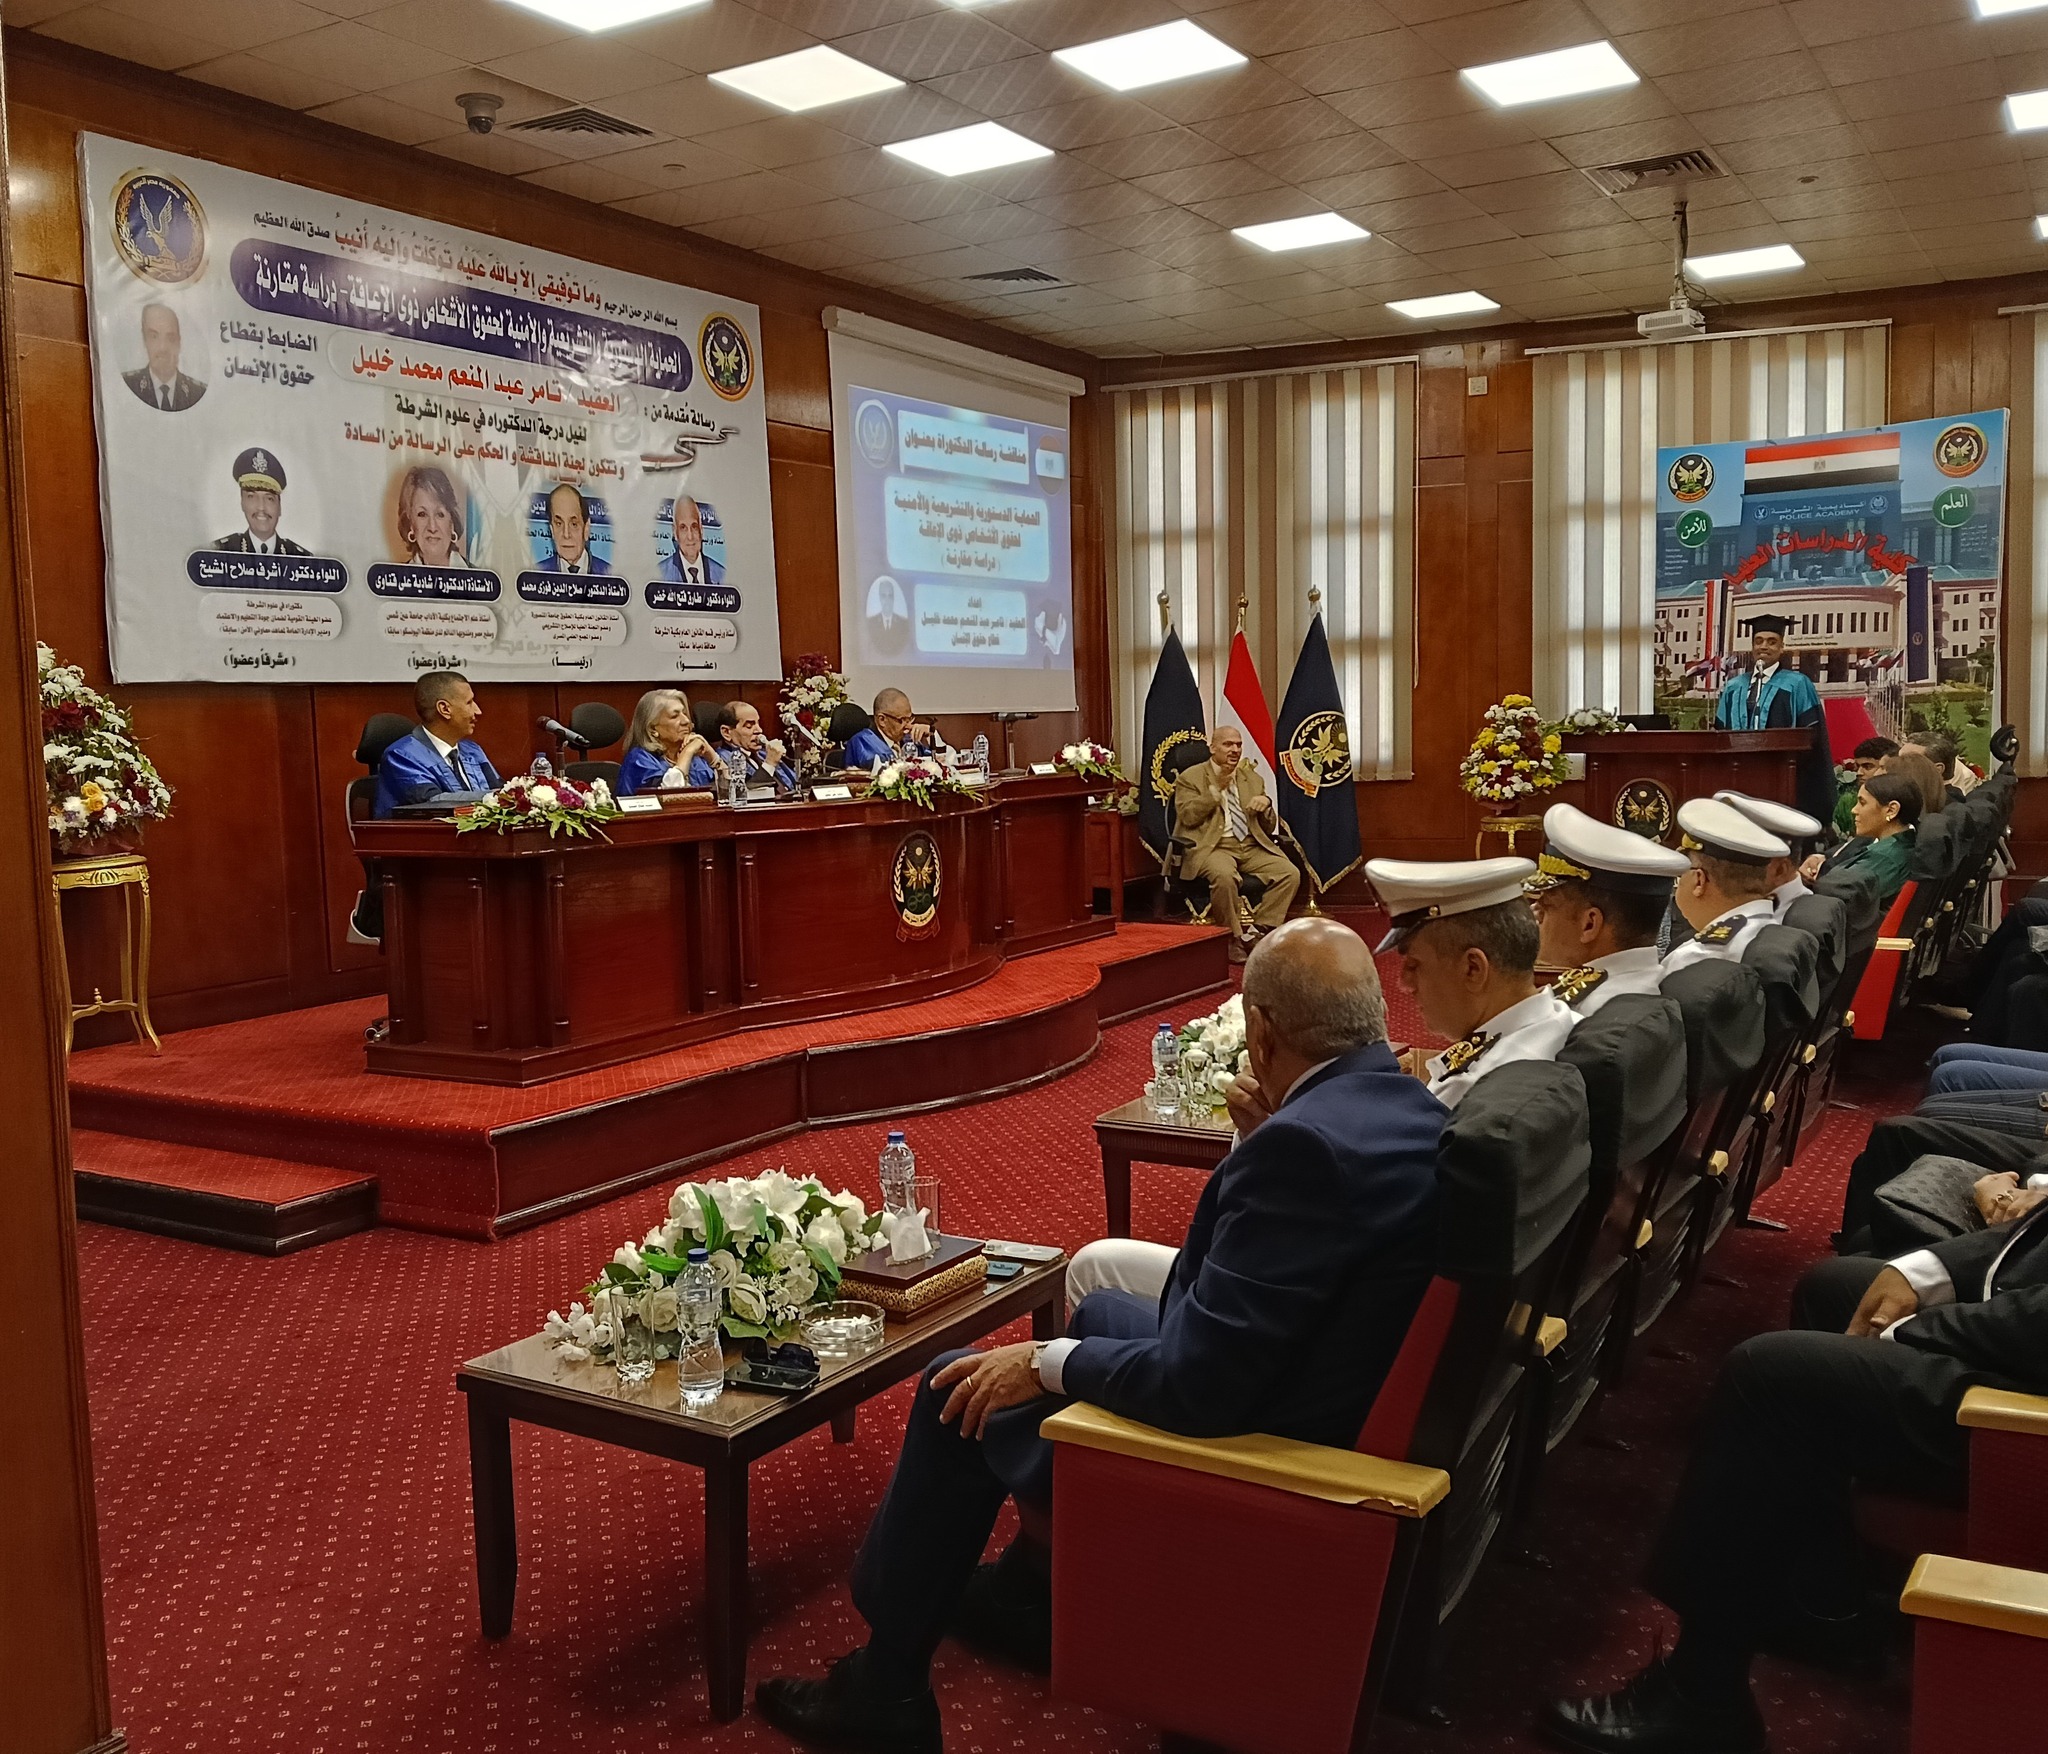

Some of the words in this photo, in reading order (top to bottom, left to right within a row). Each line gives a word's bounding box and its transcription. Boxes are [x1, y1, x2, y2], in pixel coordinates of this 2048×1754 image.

[252, 211, 288, 230] العظيم
[290, 217, 306, 233] الله
[307, 221, 330, 239] صدق
[253, 252, 300, 298] مقارنة
[299, 263, 338, 309] دراسة
[347, 274, 395, 322] الإعاقة
[604, 302, 628, 316] الرحيم
[421, 295, 471, 330] الأشخاص
[472, 303, 505, 341] لحقوق
[628, 304, 653, 322] الرحمن
[653, 310, 664, 323] الله
[664, 316, 678, 331] بسم
[219, 320, 263, 351] بقطاع
[266, 327, 318, 353] الضابط
[223, 356, 277, 385] الإنسان
[352, 344, 395, 379] خليل
[399, 355, 443, 381] محمد
[279, 363, 315, 389] حقوق
[448, 364, 490, 391] المنعم
[493, 374, 525, 401] عبد
[527, 376, 563, 406] تامر
[575, 386, 621, 416] العقيد
[394, 393, 443, 421] الشرطة
[445, 406, 471, 427] علوم
[650, 407, 663, 424] من
[473, 408, 486, 434] في
[486, 411, 537, 436] الدكتوراه
[538, 417, 565, 442] درجة
[691, 407, 716, 432] رسالة
[343, 421, 386, 444] السادة
[388, 429, 404, 451] من
[404, 428, 451, 457] الرسالة
[566, 426, 588, 443] لنيل
[453, 440, 475, 459] على
[477, 440, 509, 464] الحكم
[518, 445, 561, 470] المناقشة
[562, 451, 586, 472] لجنة
[588, 457, 617, 477] تتكون
[1779, 512, 1813, 521] POLICE
[1815, 508, 1861, 518] ACADEMY
[1941, 492, 1969, 520] العلم
[1680, 516, 1707, 540] للأمن
[1776, 527, 1870, 556] الدراسات
[1722, 542, 1777, 585] العليا
[1867, 533, 1920, 576] كلية
[199, 558, 229, 579] الشيخ
[229, 562, 256, 579] صلاح
[255, 562, 282, 581] أشرف
[288, 565, 316, 582] دكتور
[315, 568, 341, 584] اللواء
[411, 574, 434, 593] شادية
[438, 576, 468, 594] الدكتورة
[521, 582, 537, 592] محمد
[551, 583, 568, 597] الدين
[567, 583, 583, 597] صلاح
[706, 592, 721, 608] دكتور
